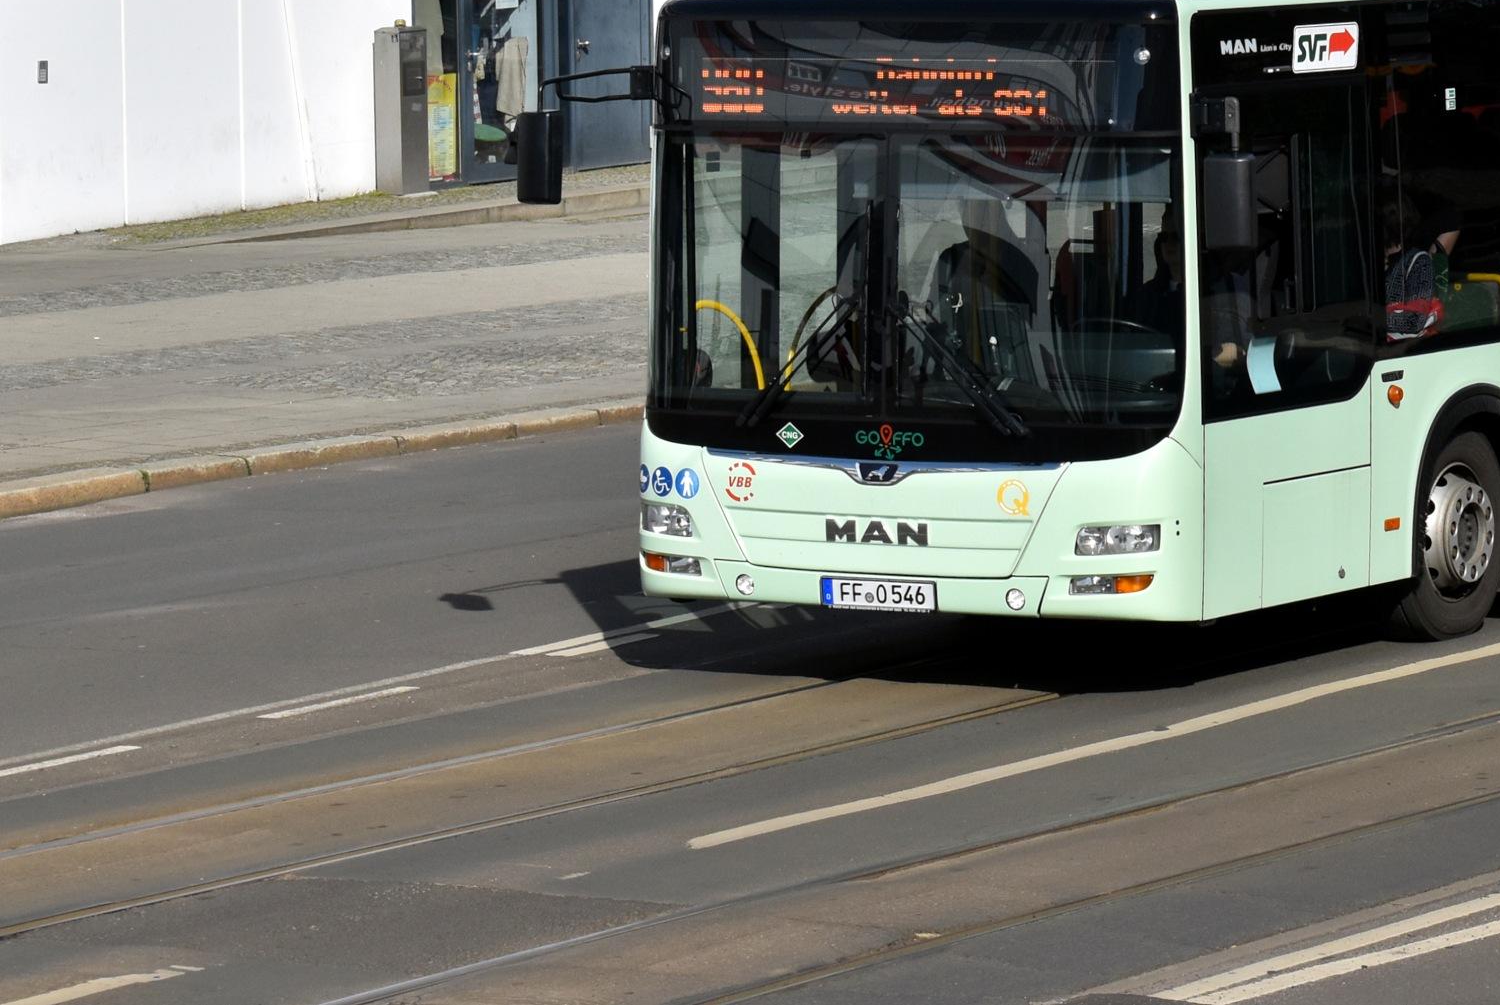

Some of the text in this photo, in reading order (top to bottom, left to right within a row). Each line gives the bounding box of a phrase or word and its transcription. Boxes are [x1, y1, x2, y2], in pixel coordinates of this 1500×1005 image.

[1220, 38, 1258, 55] MAN
[1279, 42, 1292, 52] City
[1297, 33, 1328, 63] SVF
[781, 430, 799, 440] CNG
[728, 475, 753, 489] VBB
[825, 518, 929, 546] MAN
[840, 582, 863, 602] FF
